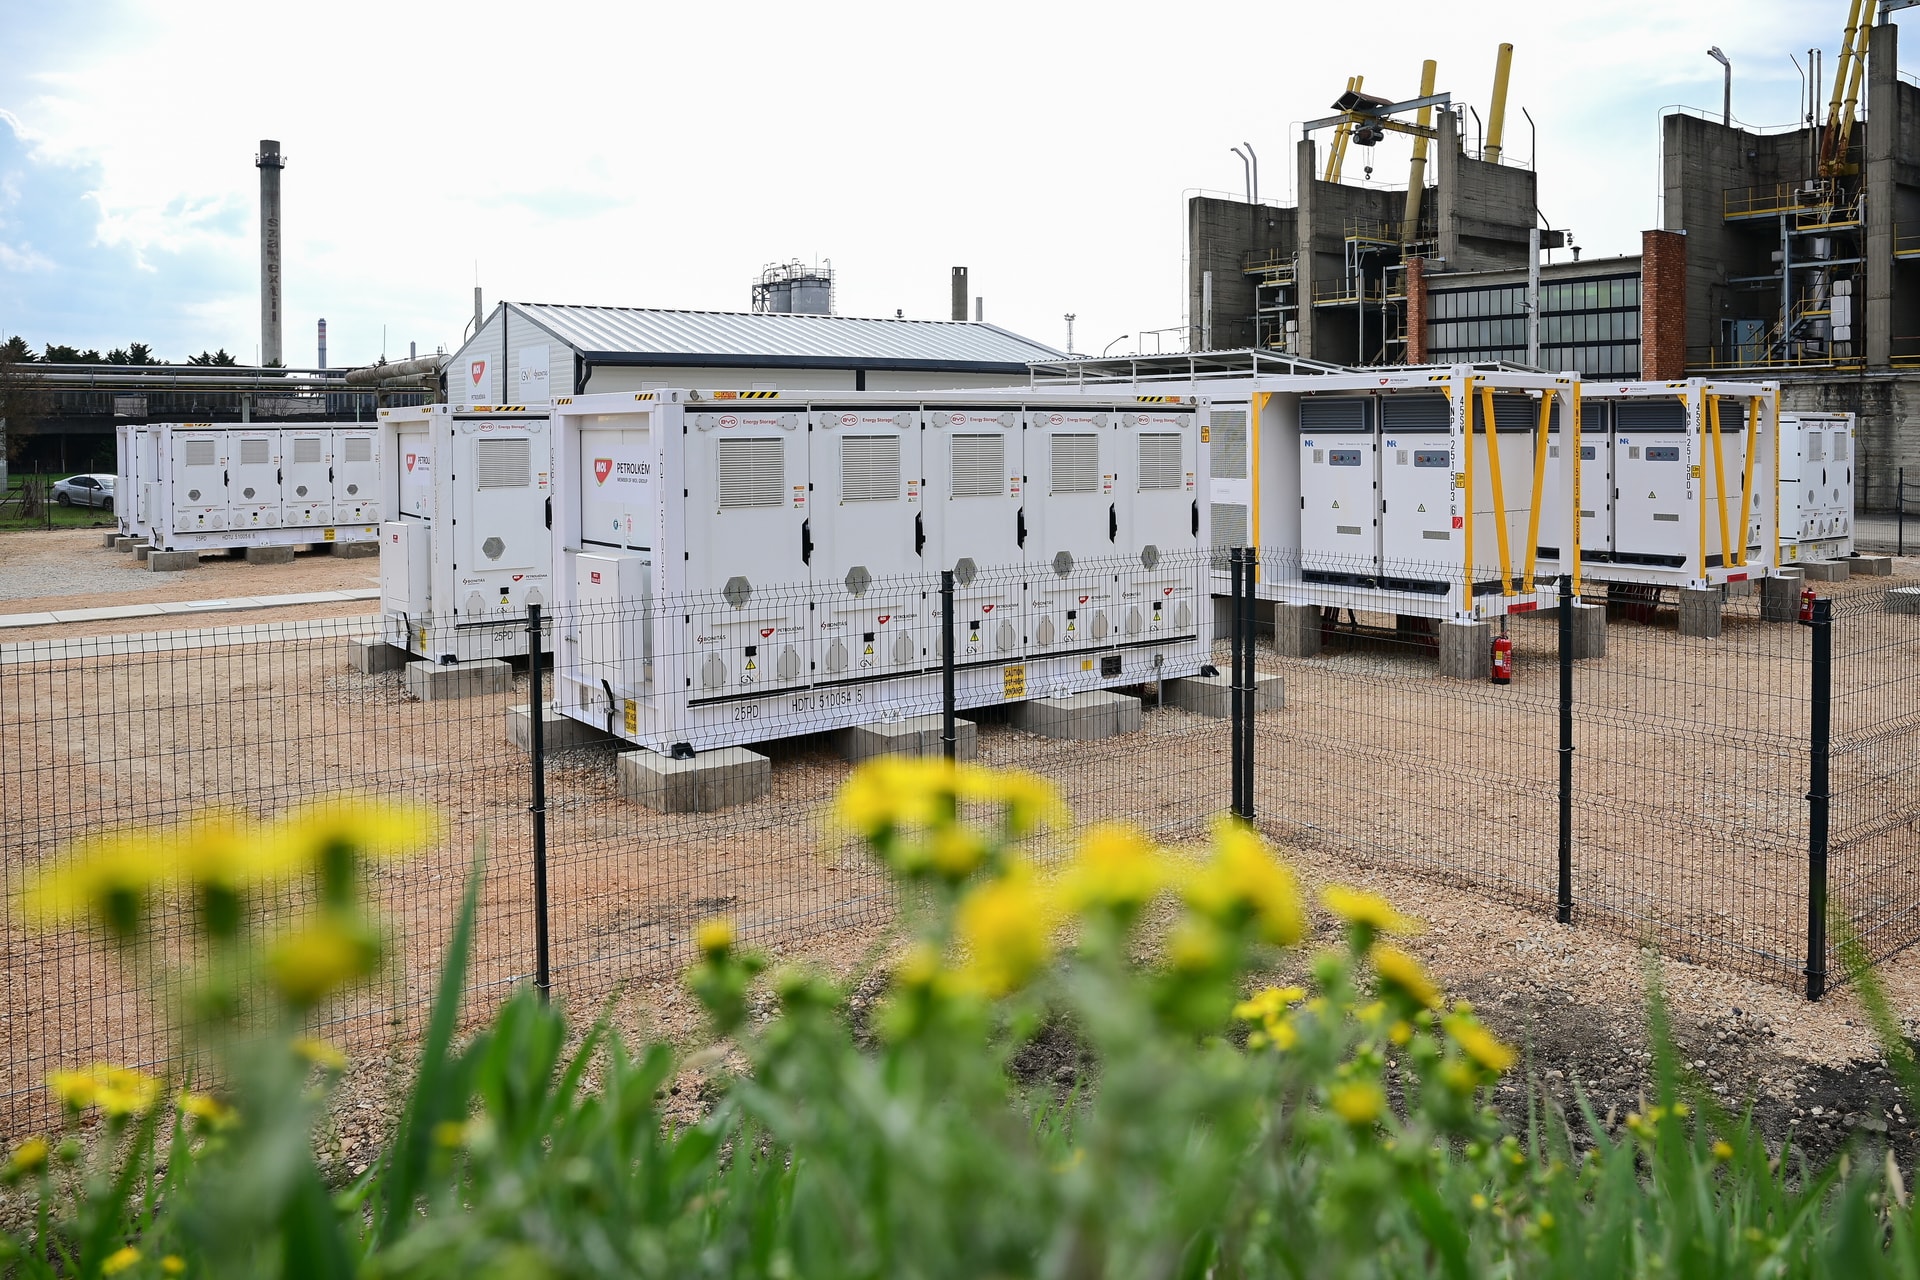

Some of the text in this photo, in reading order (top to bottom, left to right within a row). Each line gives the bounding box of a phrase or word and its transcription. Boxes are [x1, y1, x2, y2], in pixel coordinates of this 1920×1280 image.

[1304, 439, 1314, 447] NR
[1386, 439, 1397, 447] NR
[616, 460, 650, 475] PETROLKÉM
[494, 630, 514, 642] 25PD
[734, 689, 863, 721] 25PD HDTU 510054 5
